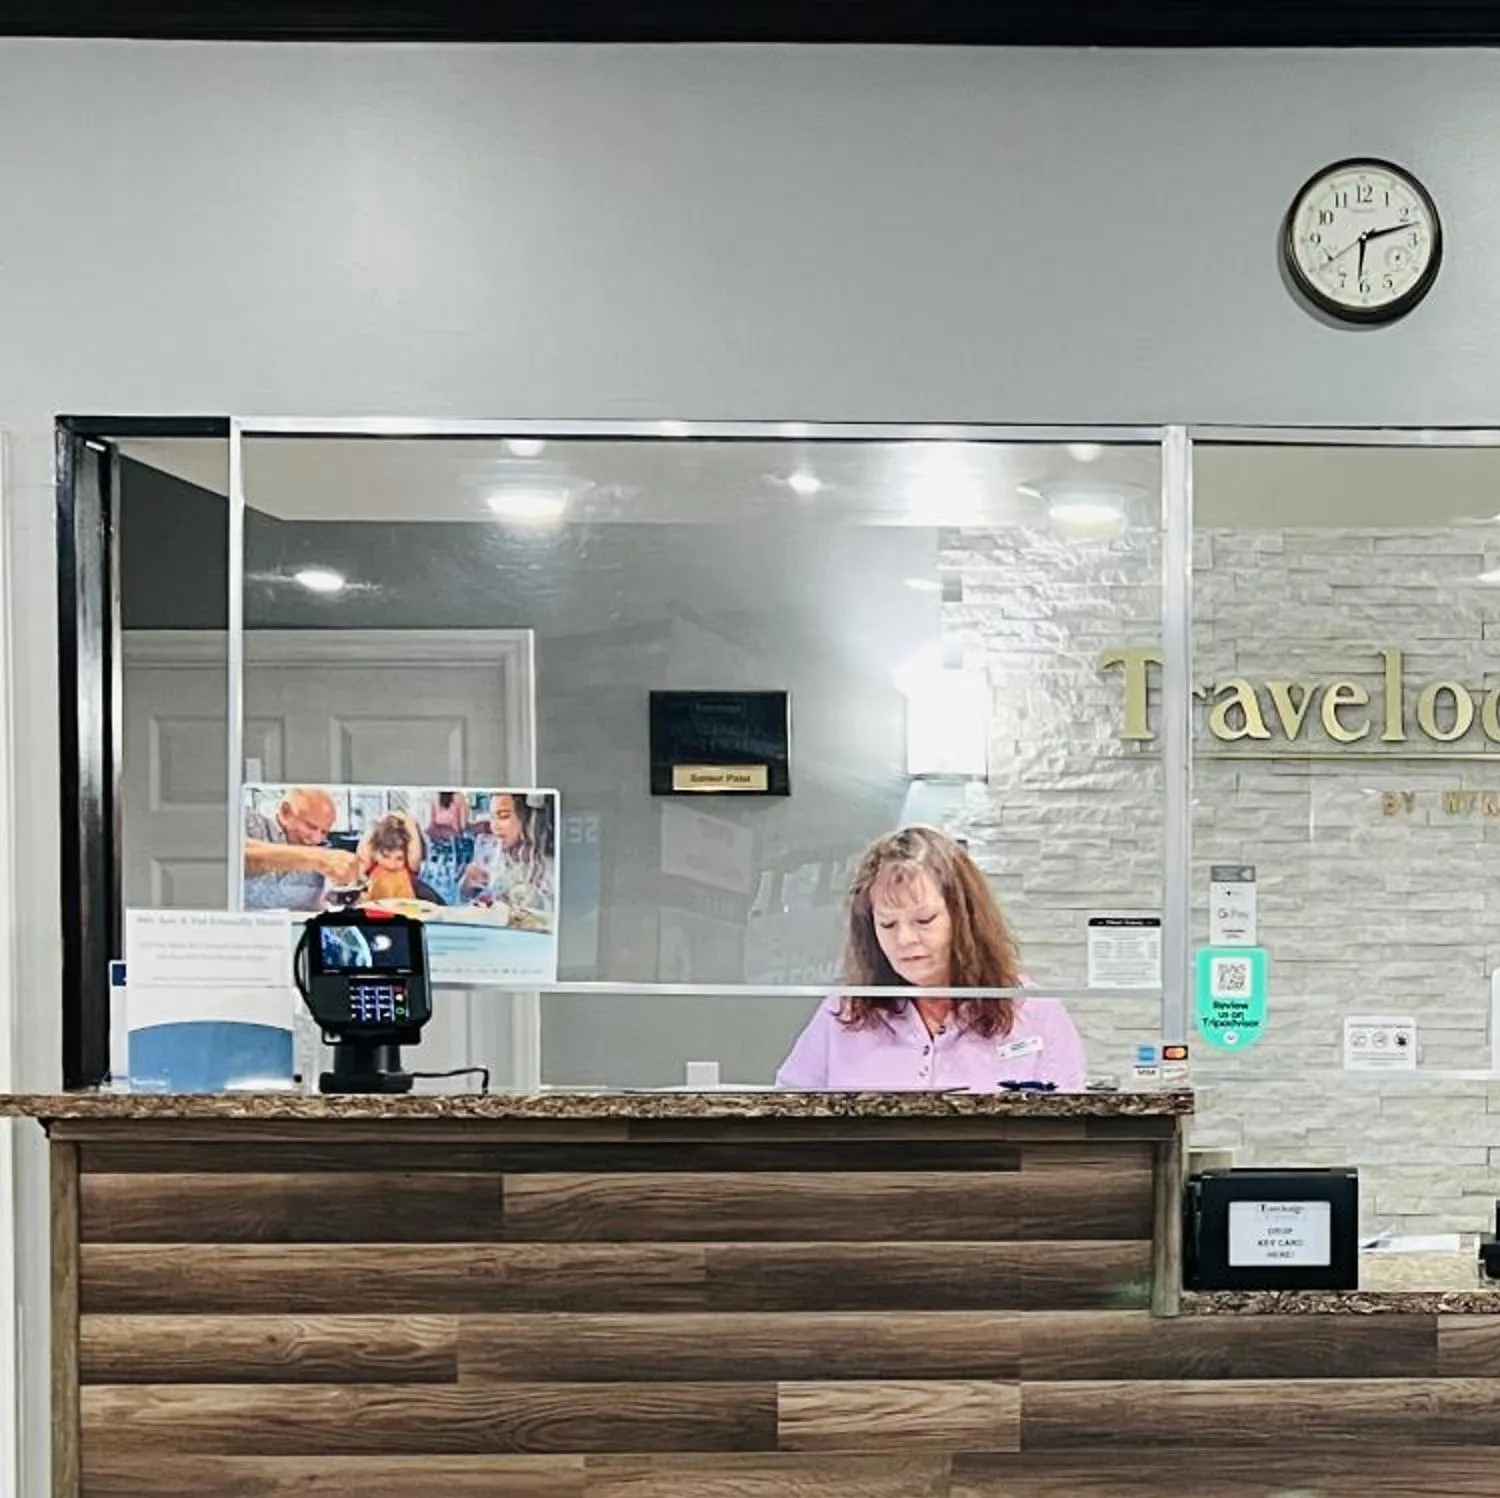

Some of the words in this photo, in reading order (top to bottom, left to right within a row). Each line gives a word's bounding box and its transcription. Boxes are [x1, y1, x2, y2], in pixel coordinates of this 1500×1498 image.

[1335, 192, 1347, 208] 11
[1356, 184, 1373, 204] 12
[1319, 210, 1334, 225] 10
[1399, 207, 1409, 223] 2
[1310, 233, 1321, 246] 9
